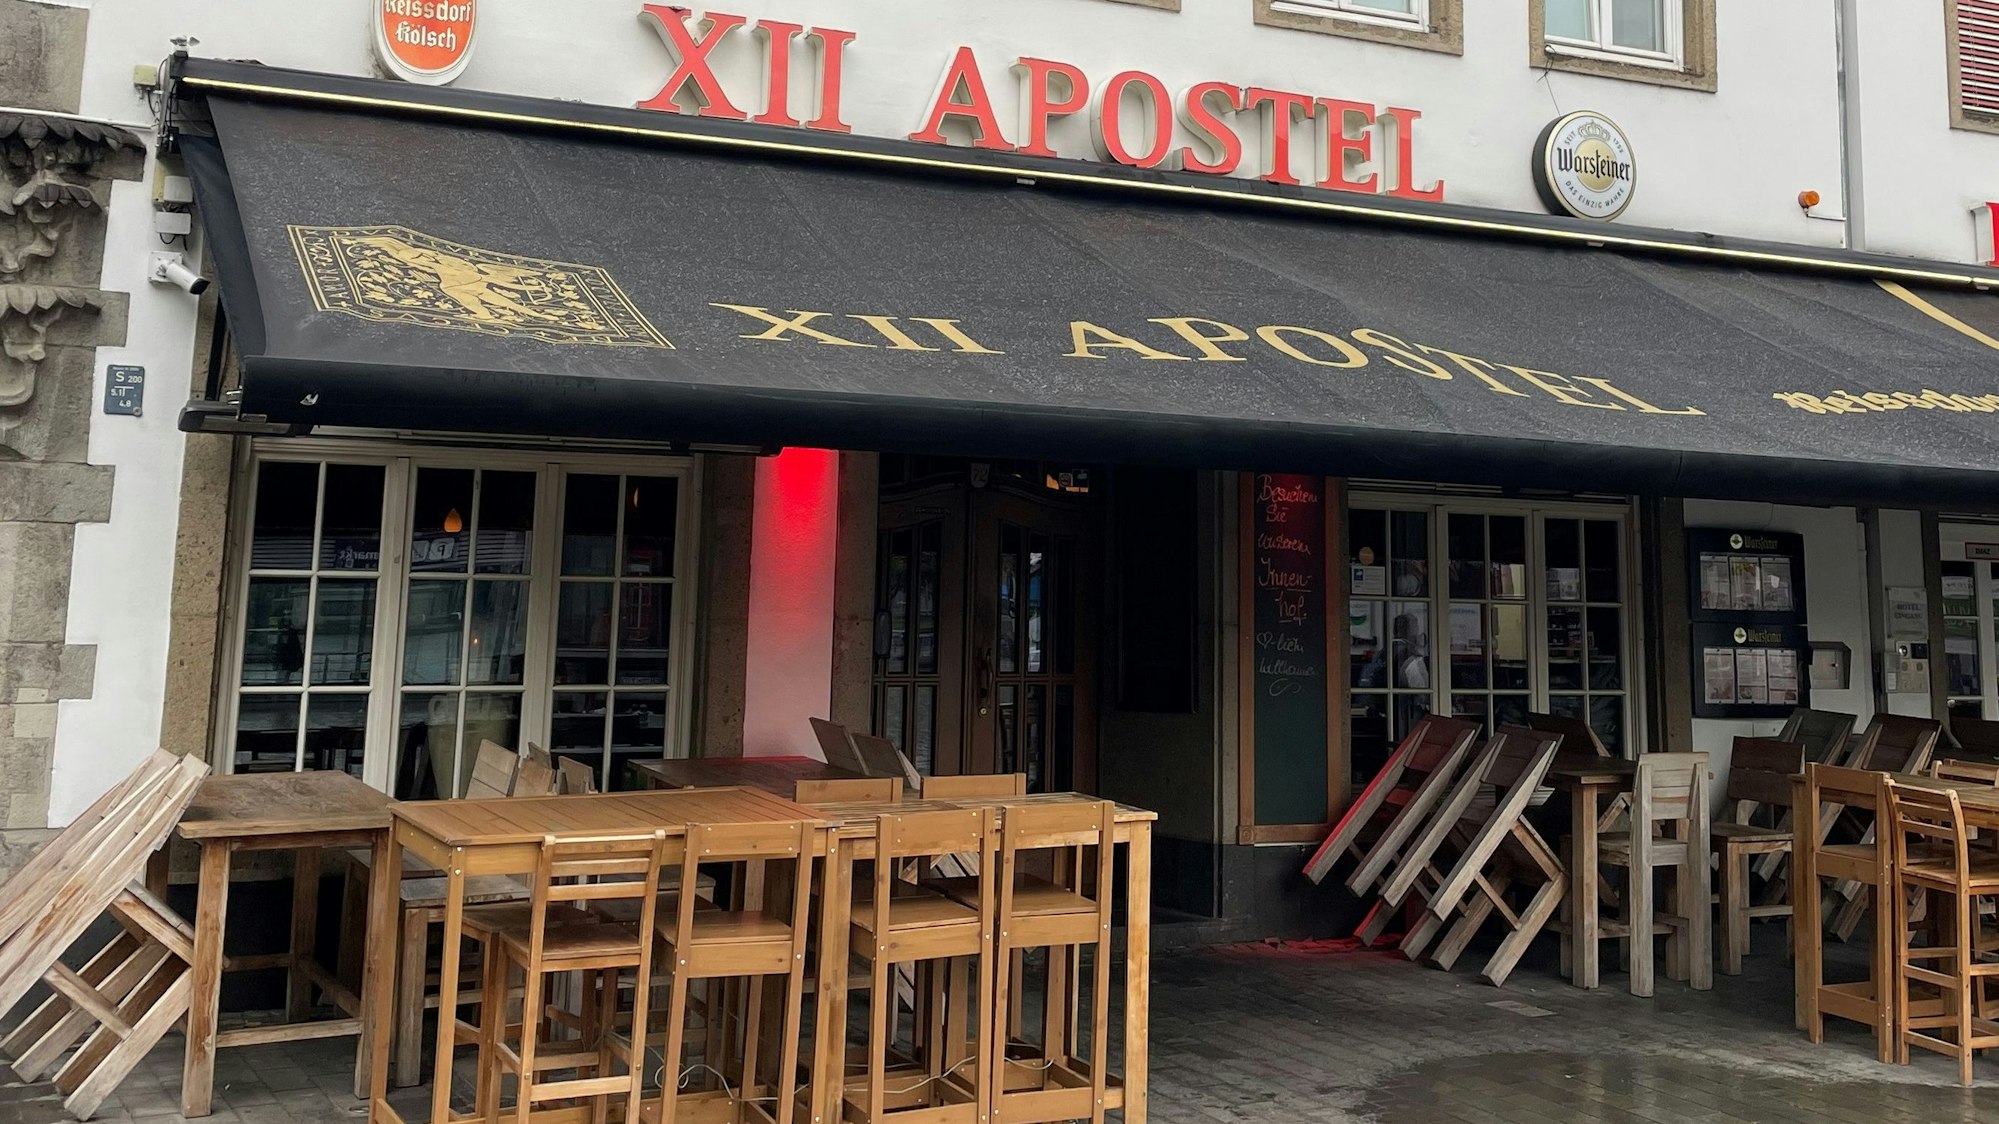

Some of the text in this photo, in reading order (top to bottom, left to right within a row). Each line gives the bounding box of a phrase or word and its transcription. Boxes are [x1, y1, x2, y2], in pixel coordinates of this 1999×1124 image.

[395, 21, 457, 52] Kölsch
[636, 3, 1445, 203] XII APOSTEL
[1564, 131, 1577, 145] SEIT
[1557, 147, 1631, 182] Warsteiner
[1565, 180, 1625, 209] DAS EINZIG WAHRE
[708, 302, 1006, 355] XII
[1062, 316, 1707, 417] APOSTEL
[115, 371, 143, 383] S 200
[1256, 474, 1319, 503] Besuchen
[1265, 504, 1290, 523] Sie
